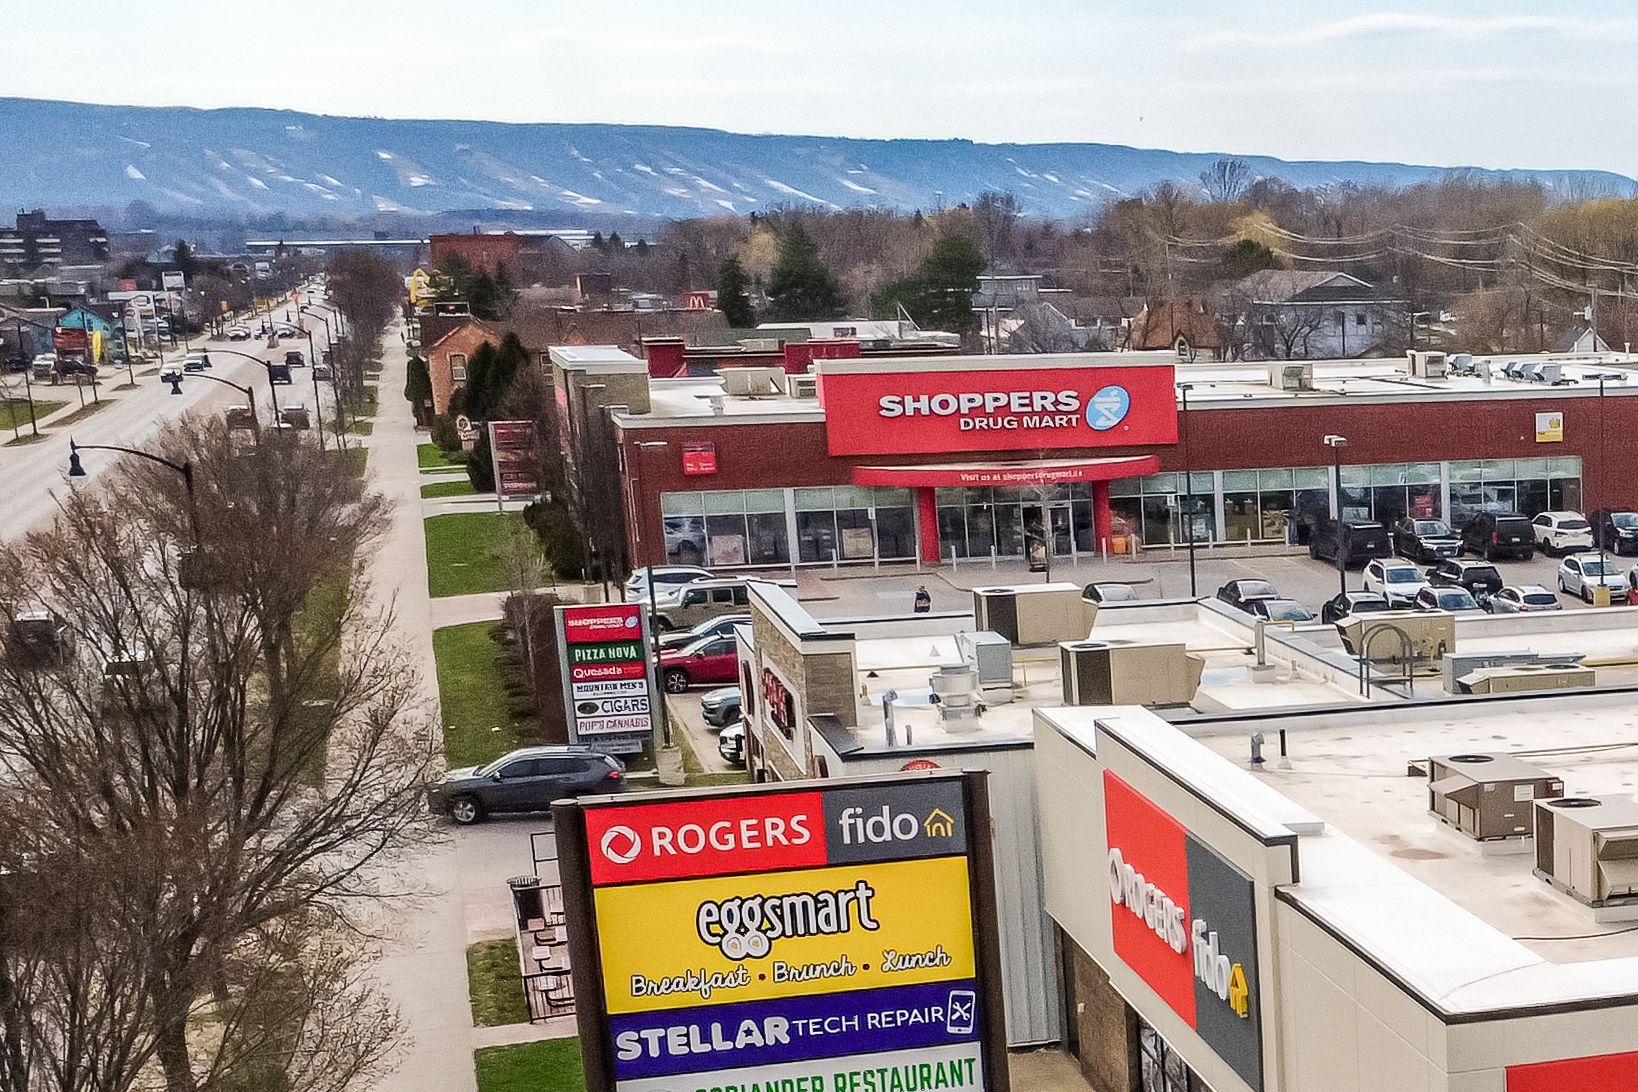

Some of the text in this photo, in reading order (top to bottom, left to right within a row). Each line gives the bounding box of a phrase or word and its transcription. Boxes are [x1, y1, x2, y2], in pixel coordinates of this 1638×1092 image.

[878, 390, 1081, 417] SHOPPERS
[959, 414, 1081, 431] DRUG MART
[574, 646, 637, 662] PIZZA NOVA
[601, 698, 648, 713] CIGARS
[652, 805, 919, 857] ROGERS fido
[697, 880, 879, 959] eggsmart
[1124, 863, 1231, 1001] ROGERS fido
[631, 945, 952, 999] Breakfast Brunch Lunch
[616, 1006, 945, 1062] STELLAR TECH REPAIR
